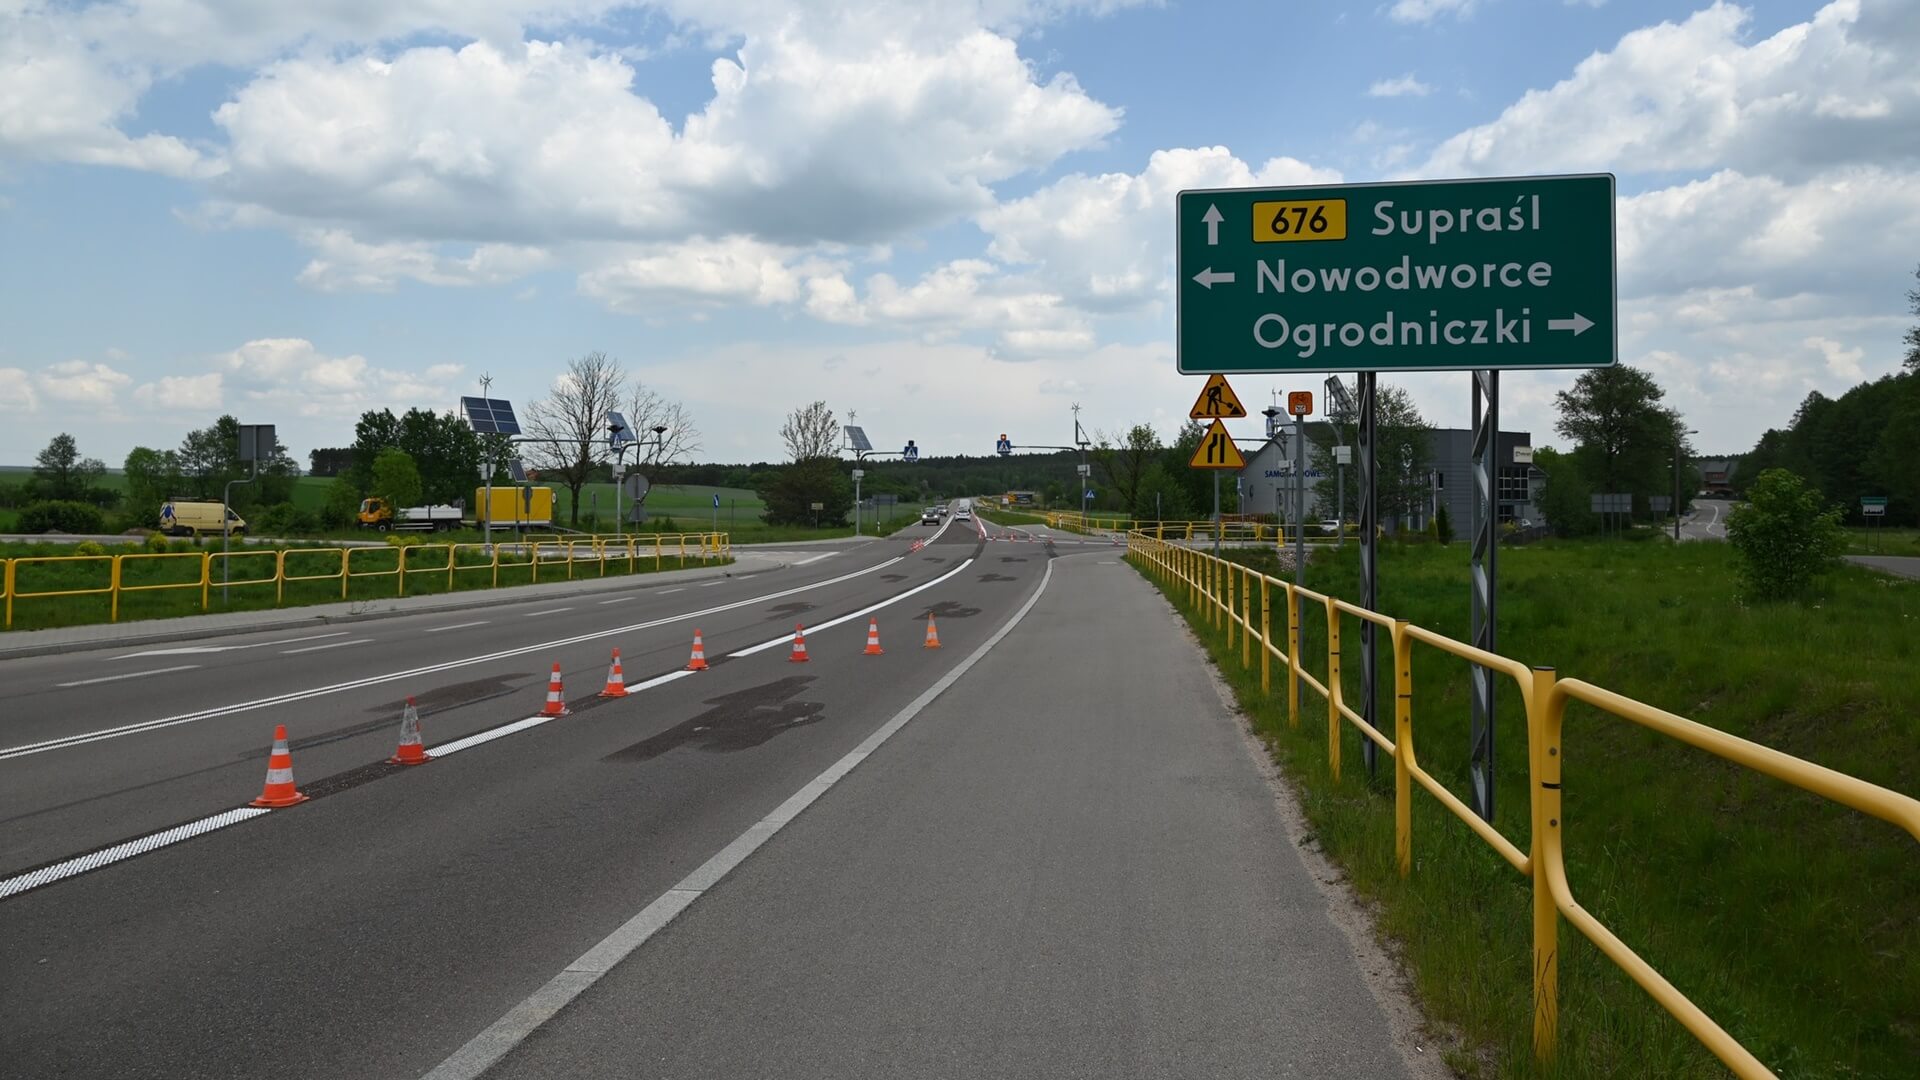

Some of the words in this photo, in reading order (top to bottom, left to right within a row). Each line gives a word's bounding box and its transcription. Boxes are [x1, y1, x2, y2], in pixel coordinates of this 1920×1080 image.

[1271, 205, 1329, 235] 676
[1371, 195, 1541, 244] Supraśl
[1257, 255, 1552, 294] Nowodworce
[1253, 308, 1531, 358] Ogrodniczki
